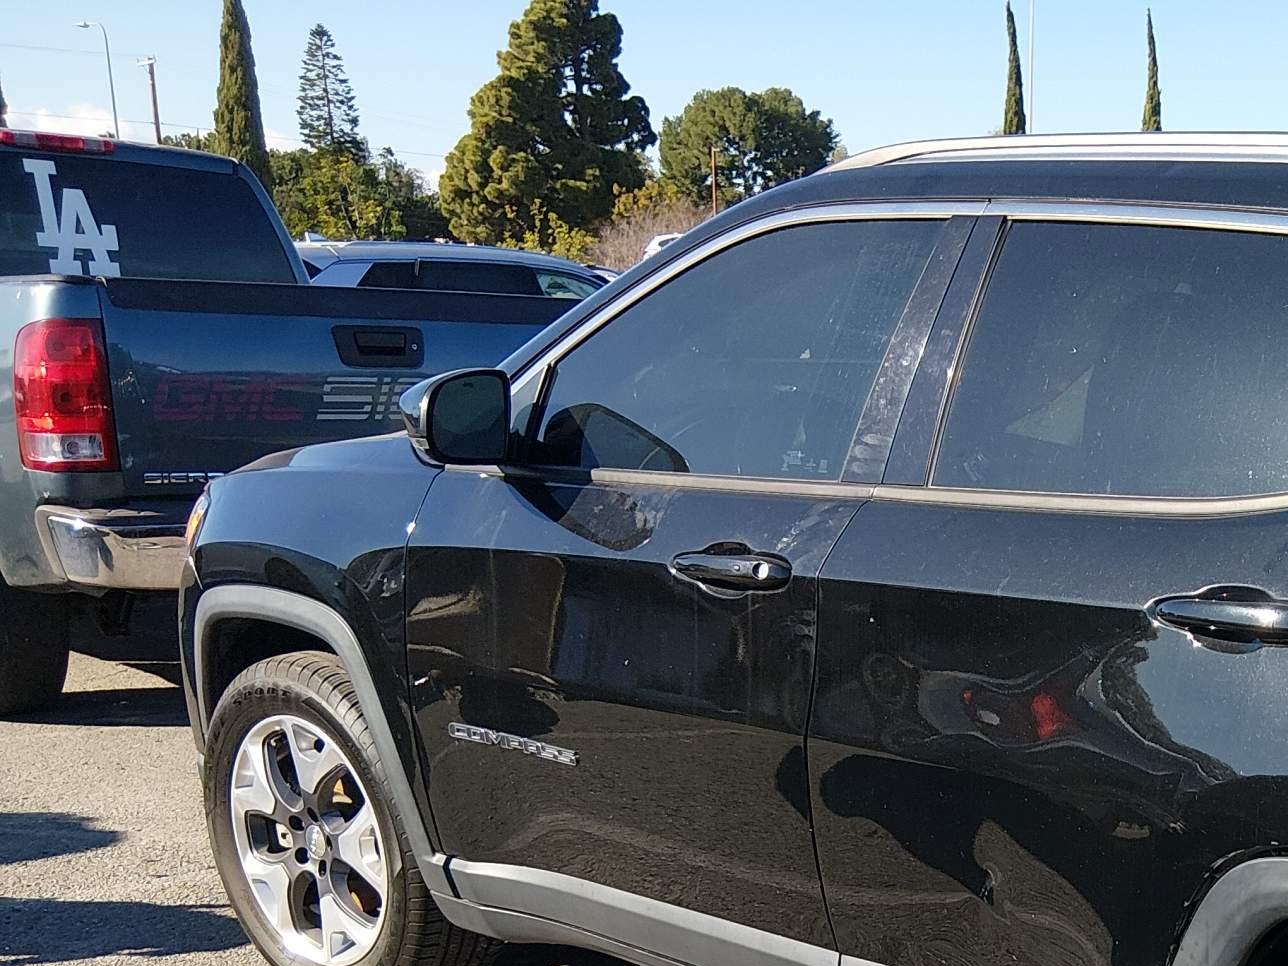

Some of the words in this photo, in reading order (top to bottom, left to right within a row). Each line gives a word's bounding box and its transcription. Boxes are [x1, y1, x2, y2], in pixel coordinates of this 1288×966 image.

[22, 157, 121, 278] LA
[155, 374, 316, 422] GMC
[448, 722, 579, 766] COMPASS
